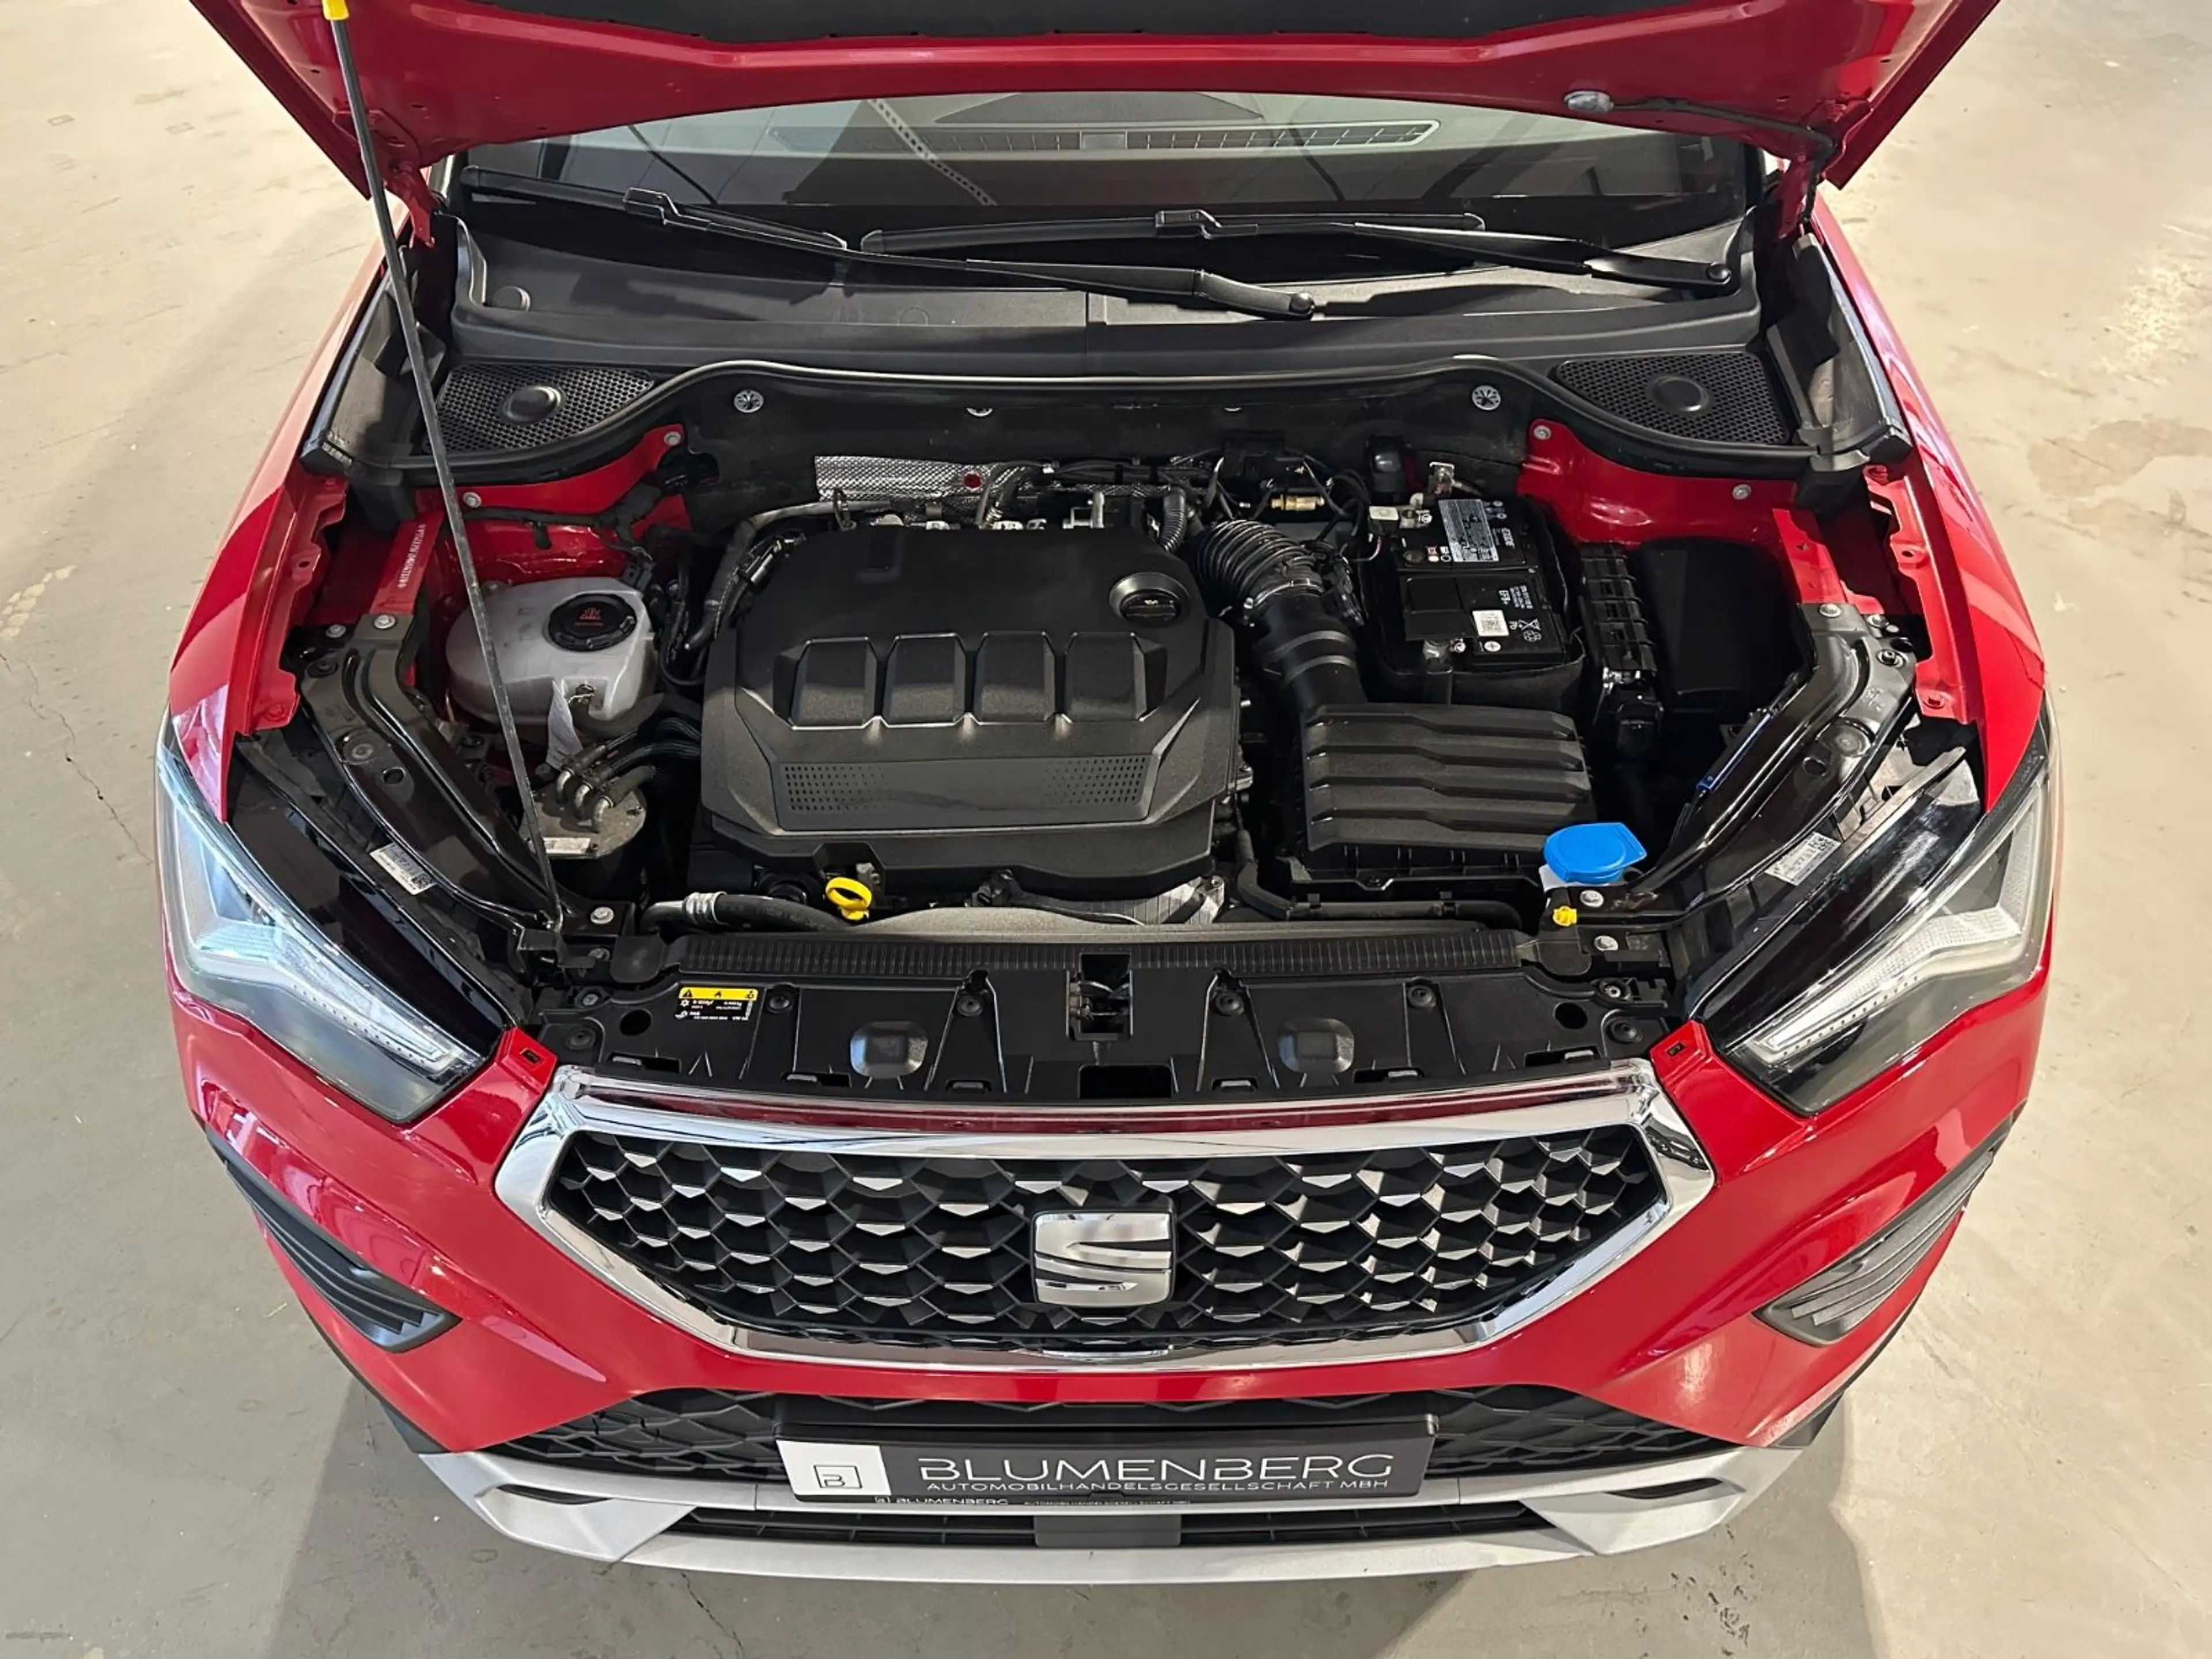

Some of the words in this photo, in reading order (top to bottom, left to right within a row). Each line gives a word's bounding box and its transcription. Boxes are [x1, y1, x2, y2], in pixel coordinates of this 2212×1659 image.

[918, 1453, 1394, 1481] BLUMENBERG
[927, 1481, 1334, 1491] AUTOMOBILHANDELSGESELLSCHAFT
[1339, 1480, 1388, 1488] MBH
